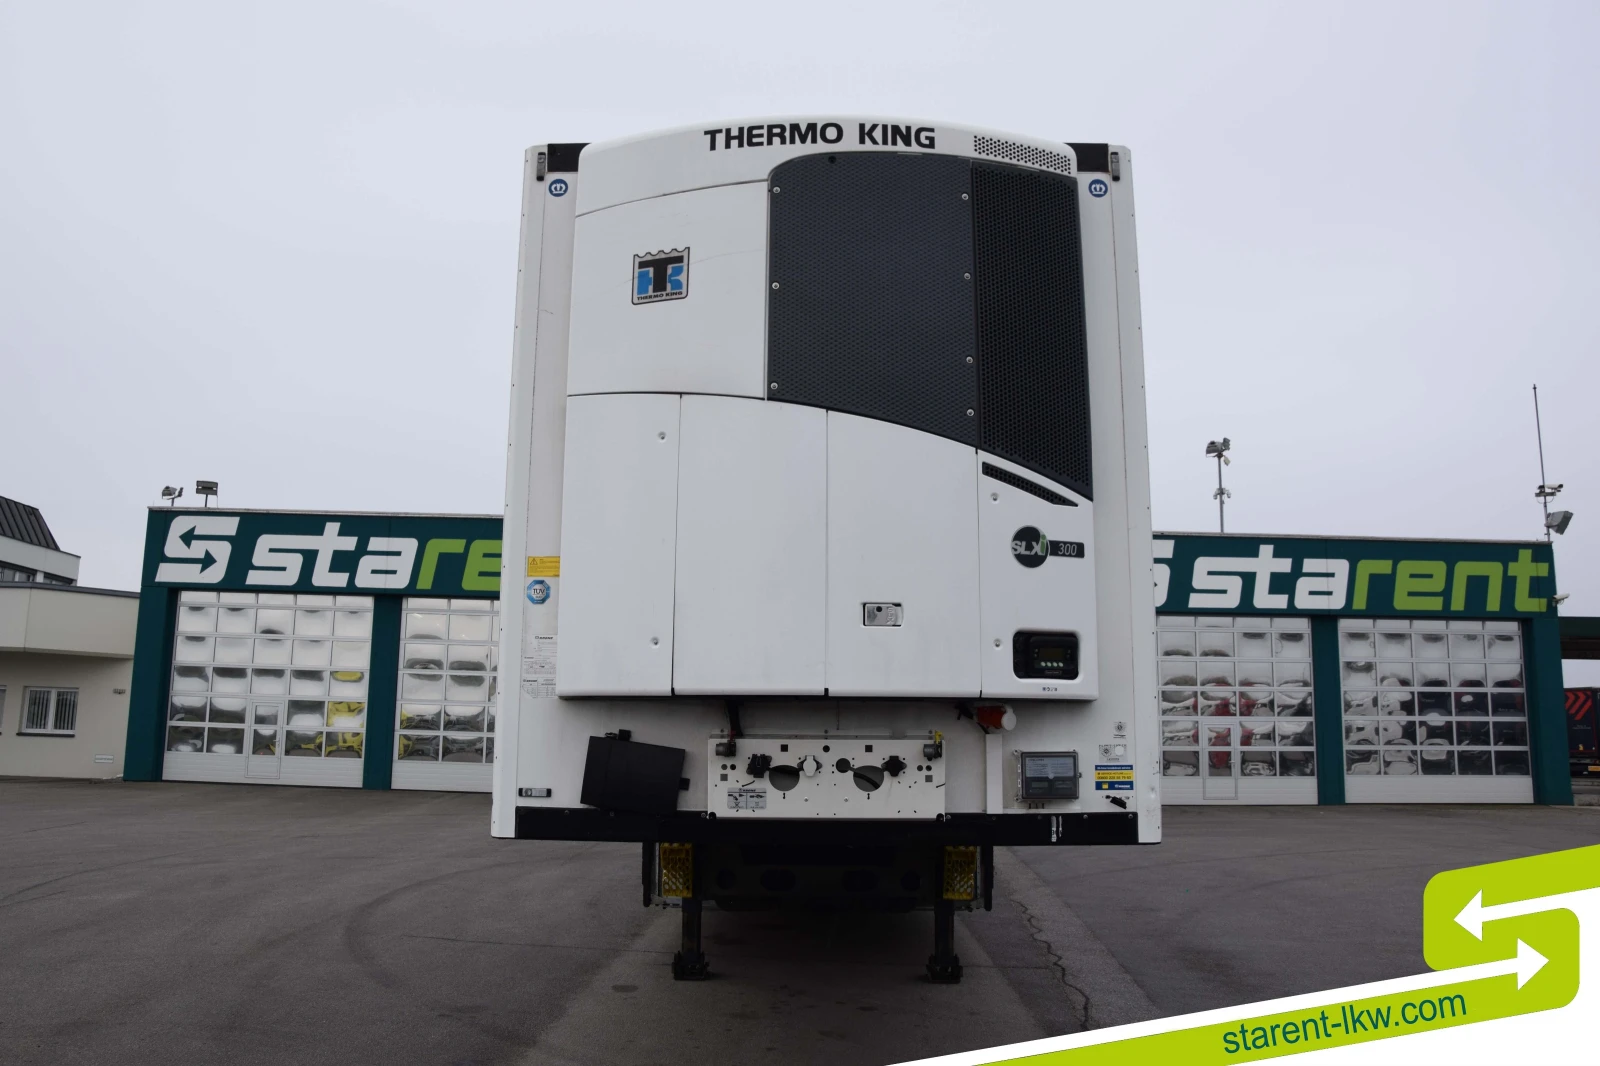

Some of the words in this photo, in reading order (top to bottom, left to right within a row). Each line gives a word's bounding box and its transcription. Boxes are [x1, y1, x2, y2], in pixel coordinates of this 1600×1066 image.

[703, 122, 844, 152] THERMO
[858, 122, 936, 150] KING
[637, 293, 664, 301] THERMO
[1058, 542, 1078, 556] 300
[1188, 544, 1550, 613] starent
